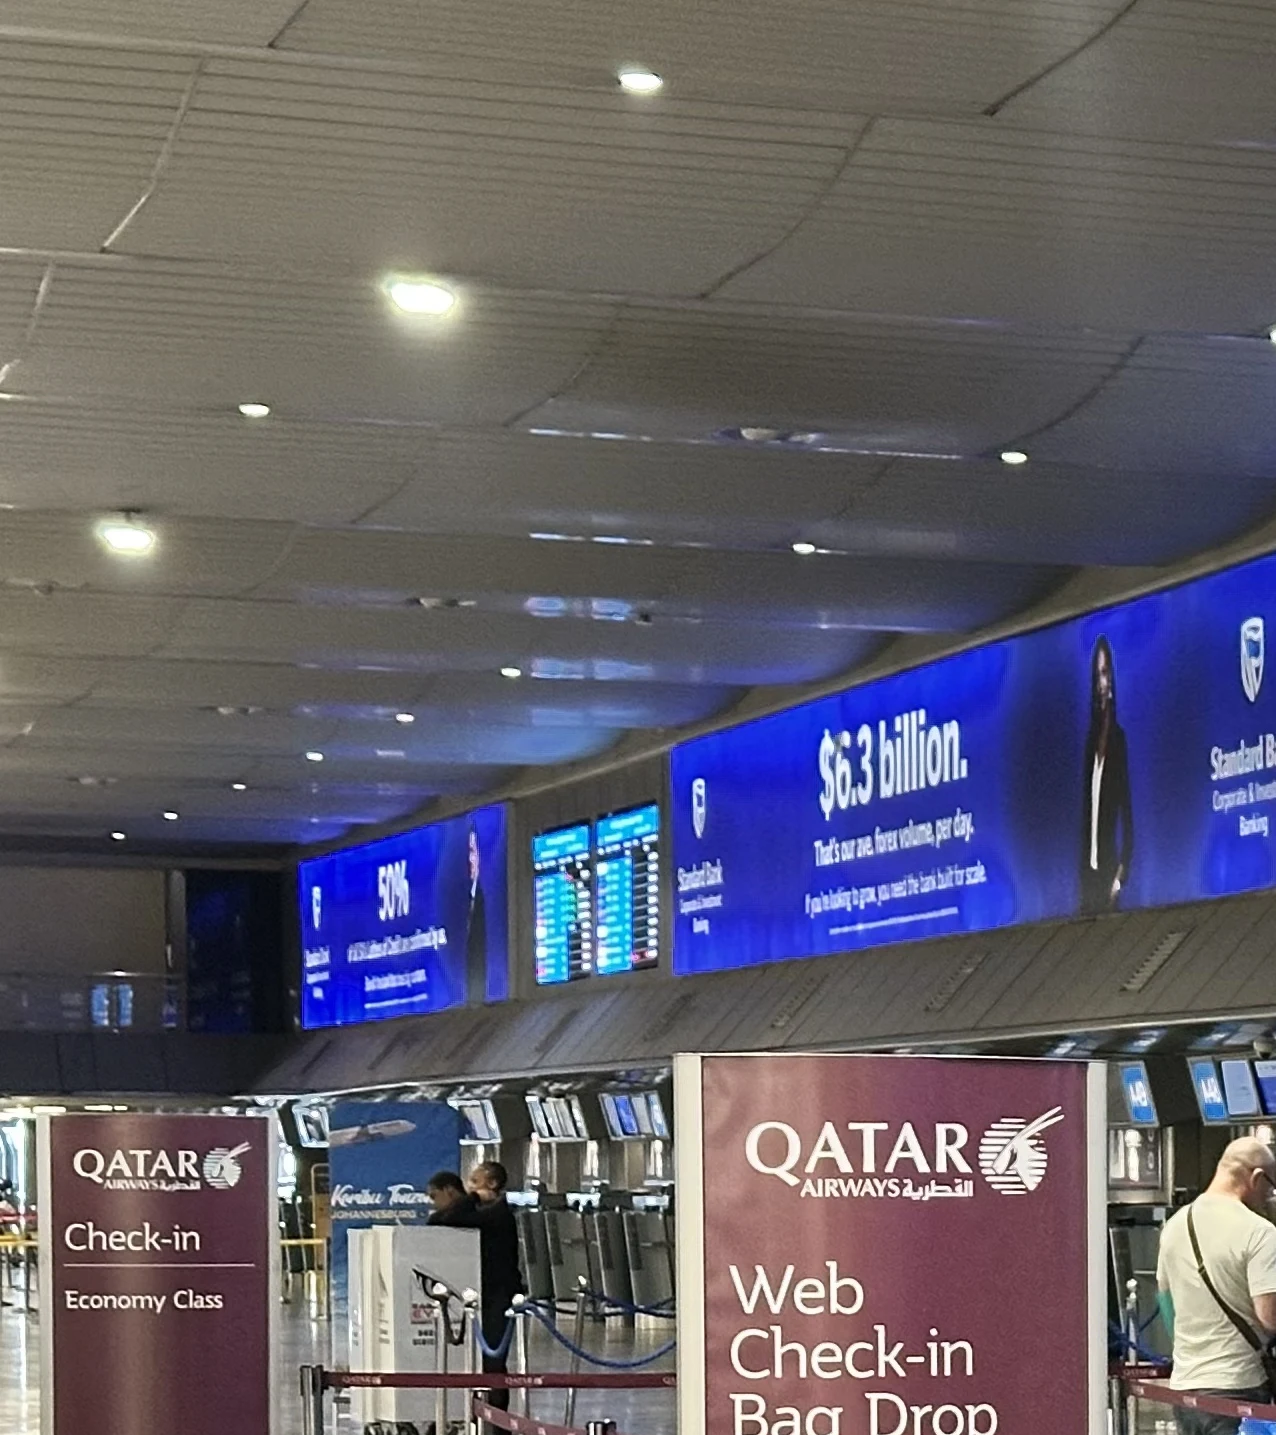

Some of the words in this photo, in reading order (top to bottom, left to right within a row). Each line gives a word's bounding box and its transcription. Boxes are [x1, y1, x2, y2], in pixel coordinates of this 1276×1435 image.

[818, 728, 874, 821] $6.3
[879, 708, 968, 799] billion.
[1210, 735, 1264, 781] Standard
[874, 826, 899, 854] forex
[935, 816, 953, 849] per
[378, 860, 410, 921] 50%
[73, 1148, 200, 1184] QATAR
[744, 1120, 974, 1187] QATAR
[800, 1177, 901, 1200] AIRWAYS
[902, 1177, 975, 1202] القطرية
[64, 1221, 201, 1252] Check-in
[64, 1290, 167, 1315] Economy
[173, 1288, 224, 1310] Class
[728, 1260, 866, 1317] Web
[728, 1323, 976, 1380] Check-in
